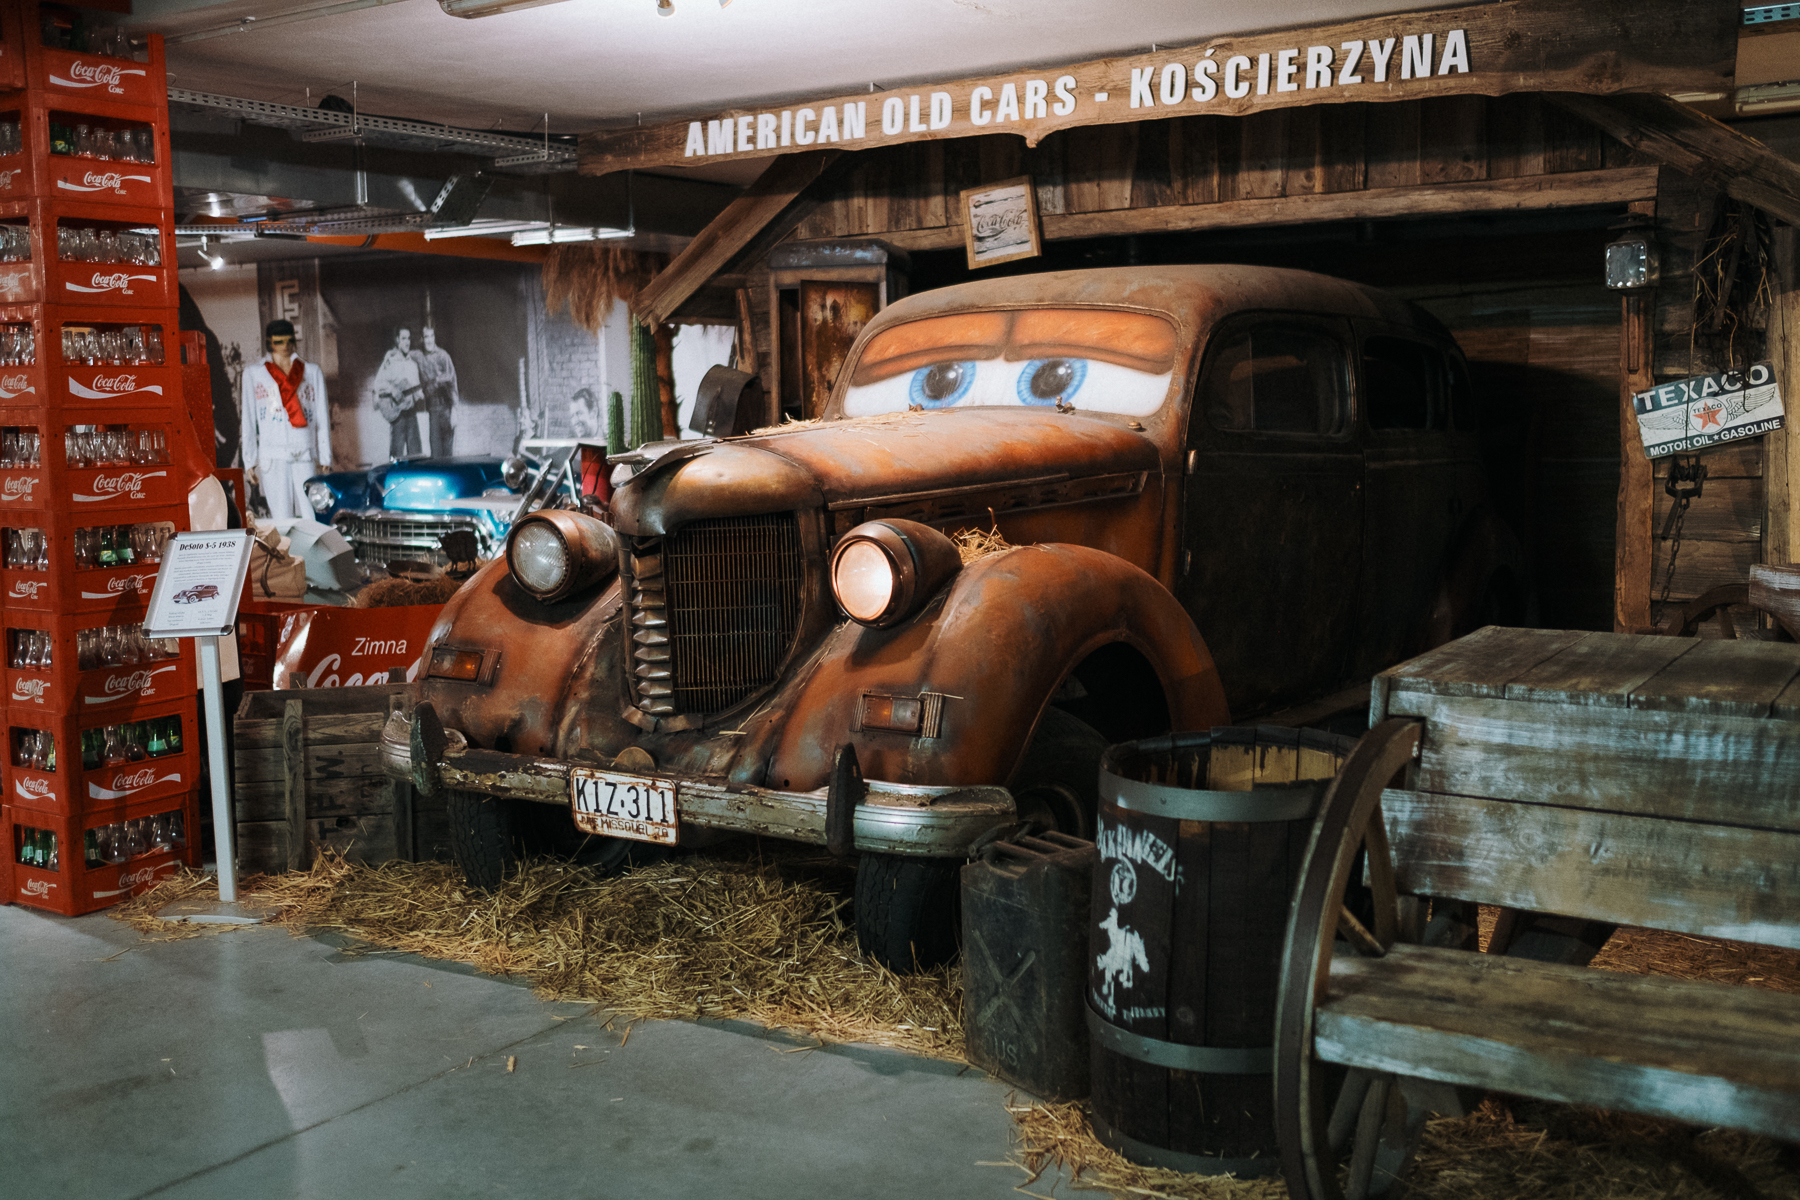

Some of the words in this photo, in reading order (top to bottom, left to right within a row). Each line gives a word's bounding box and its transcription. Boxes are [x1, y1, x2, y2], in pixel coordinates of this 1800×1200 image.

[70, 60, 121, 85] Coca-Cola
[684, 101, 866, 157] AMERICAN
[881, 91, 954, 136] OLD
[970, 75, 1078, 126] CARS
[1094, 91, 1109, 102] -
[1129, 29, 1471, 109] KOŚCIERZYNA
[83, 171, 122, 188] Coca-Cola
[91, 272, 129, 288] Coca-Cola
[92, 374, 138, 391] Coca-Cola
[1638, 364, 1769, 411] TEXACO
[1650, 440, 1692, 457] MOTOR
[1693, 435, 1713, 447] OIL
[1720, 419, 1781, 441] GASOLINE
[93, 472, 143, 493] Coca-Cola
[179, 543, 204, 551] DeSoto
[107, 574, 144, 592] Coca-Cola
[351, 637, 407, 656] Zimna
[104, 670, 153, 693] Coca-Cola
[112, 767, 157, 791] Coca-Cola
